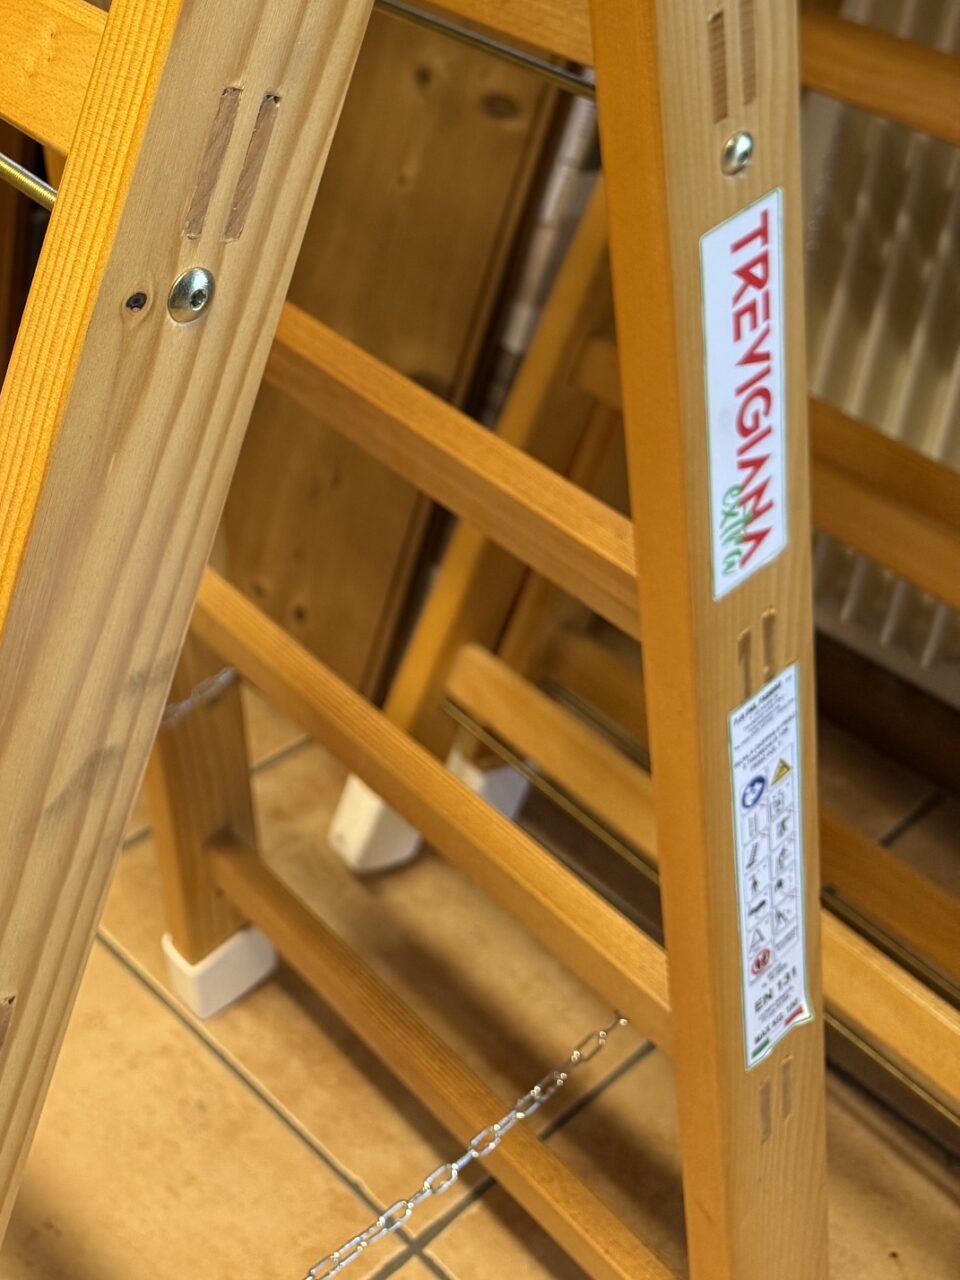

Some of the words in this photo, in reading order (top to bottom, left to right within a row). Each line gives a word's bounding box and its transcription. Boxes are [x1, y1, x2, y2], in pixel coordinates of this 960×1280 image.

[730, 208, 775, 569] TREVIGIANA
[719, 483, 751, 576] extra
[754, 987, 773, 1013] EN
